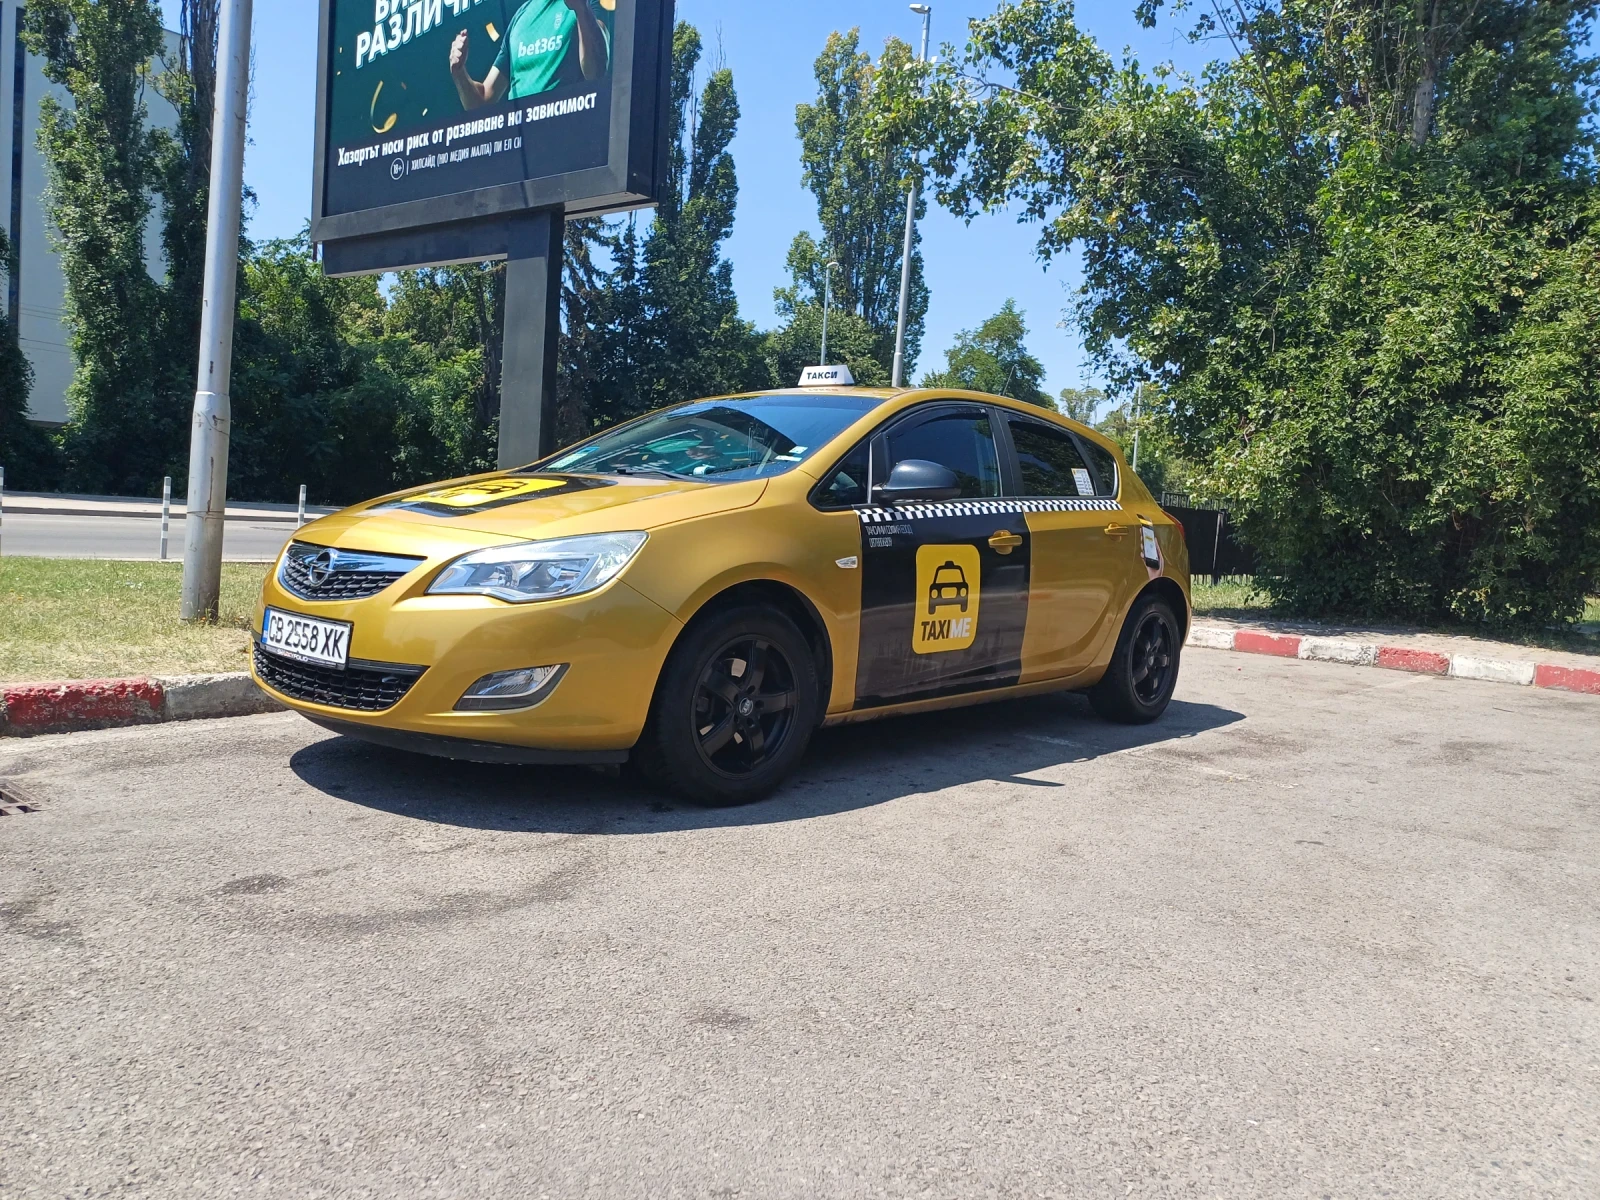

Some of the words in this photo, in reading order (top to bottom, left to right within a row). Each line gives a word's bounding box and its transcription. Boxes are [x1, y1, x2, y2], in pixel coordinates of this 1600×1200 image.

[518, 35, 563, 58] bet365
[338, 144, 380, 167] Хазартът
[382, 138, 404, 156] носи
[406, 132, 430, 156] риск
[432, 128, 444, 144] от
[446, 114, 504, 147] развиване
[507, 109, 522, 127] на
[525, 92, 597, 123] зависимост
[806, 371, 838, 379] ТАКСИ
[269, 615, 284, 643] CB
[284, 619, 319, 653] 2558
[320, 626, 345, 660] XK
